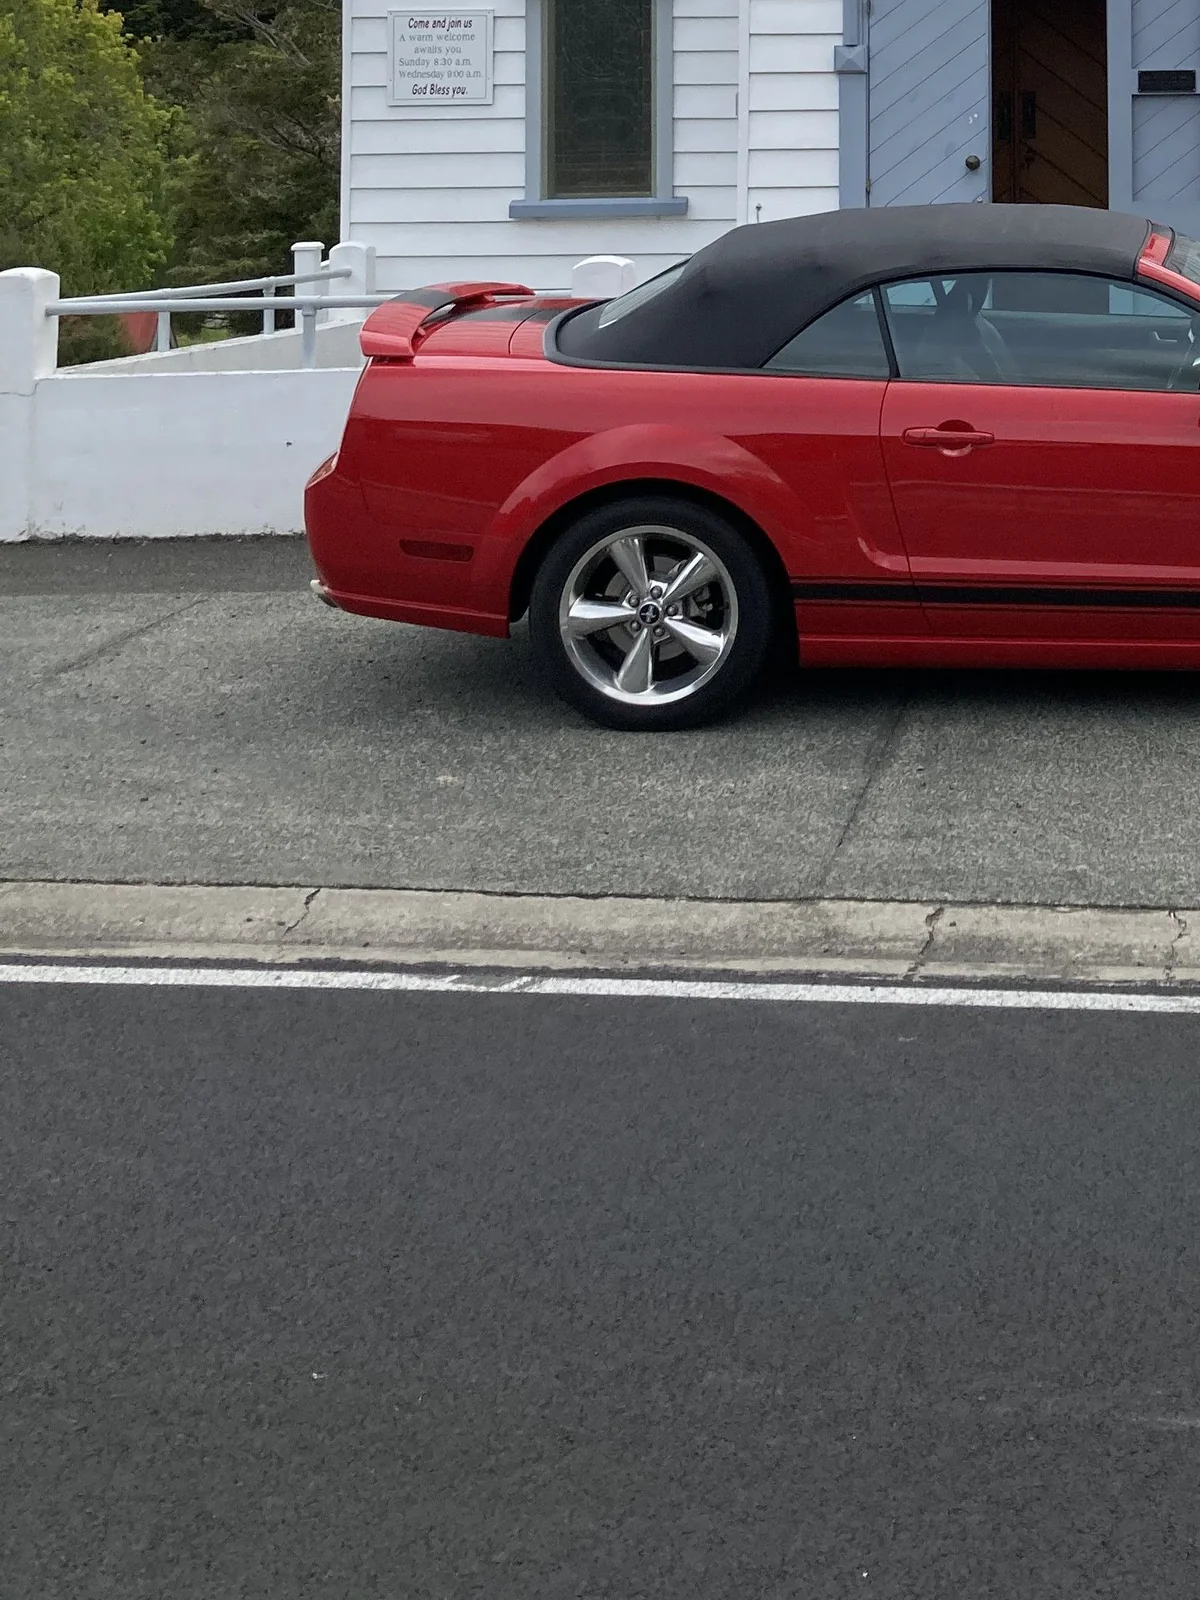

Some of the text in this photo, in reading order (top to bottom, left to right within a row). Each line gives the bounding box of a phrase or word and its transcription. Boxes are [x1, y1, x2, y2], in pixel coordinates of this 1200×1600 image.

[408, 17, 473, 32] Come and join us
[399, 33, 406, 42] A
[436, 32, 476, 41] welcome
[414, 45, 462, 56] awaits you
[398, 57, 430, 67] Sunday
[398, 70, 445, 80] Wednesday
[412, 83, 469, 99] God Bless you.
